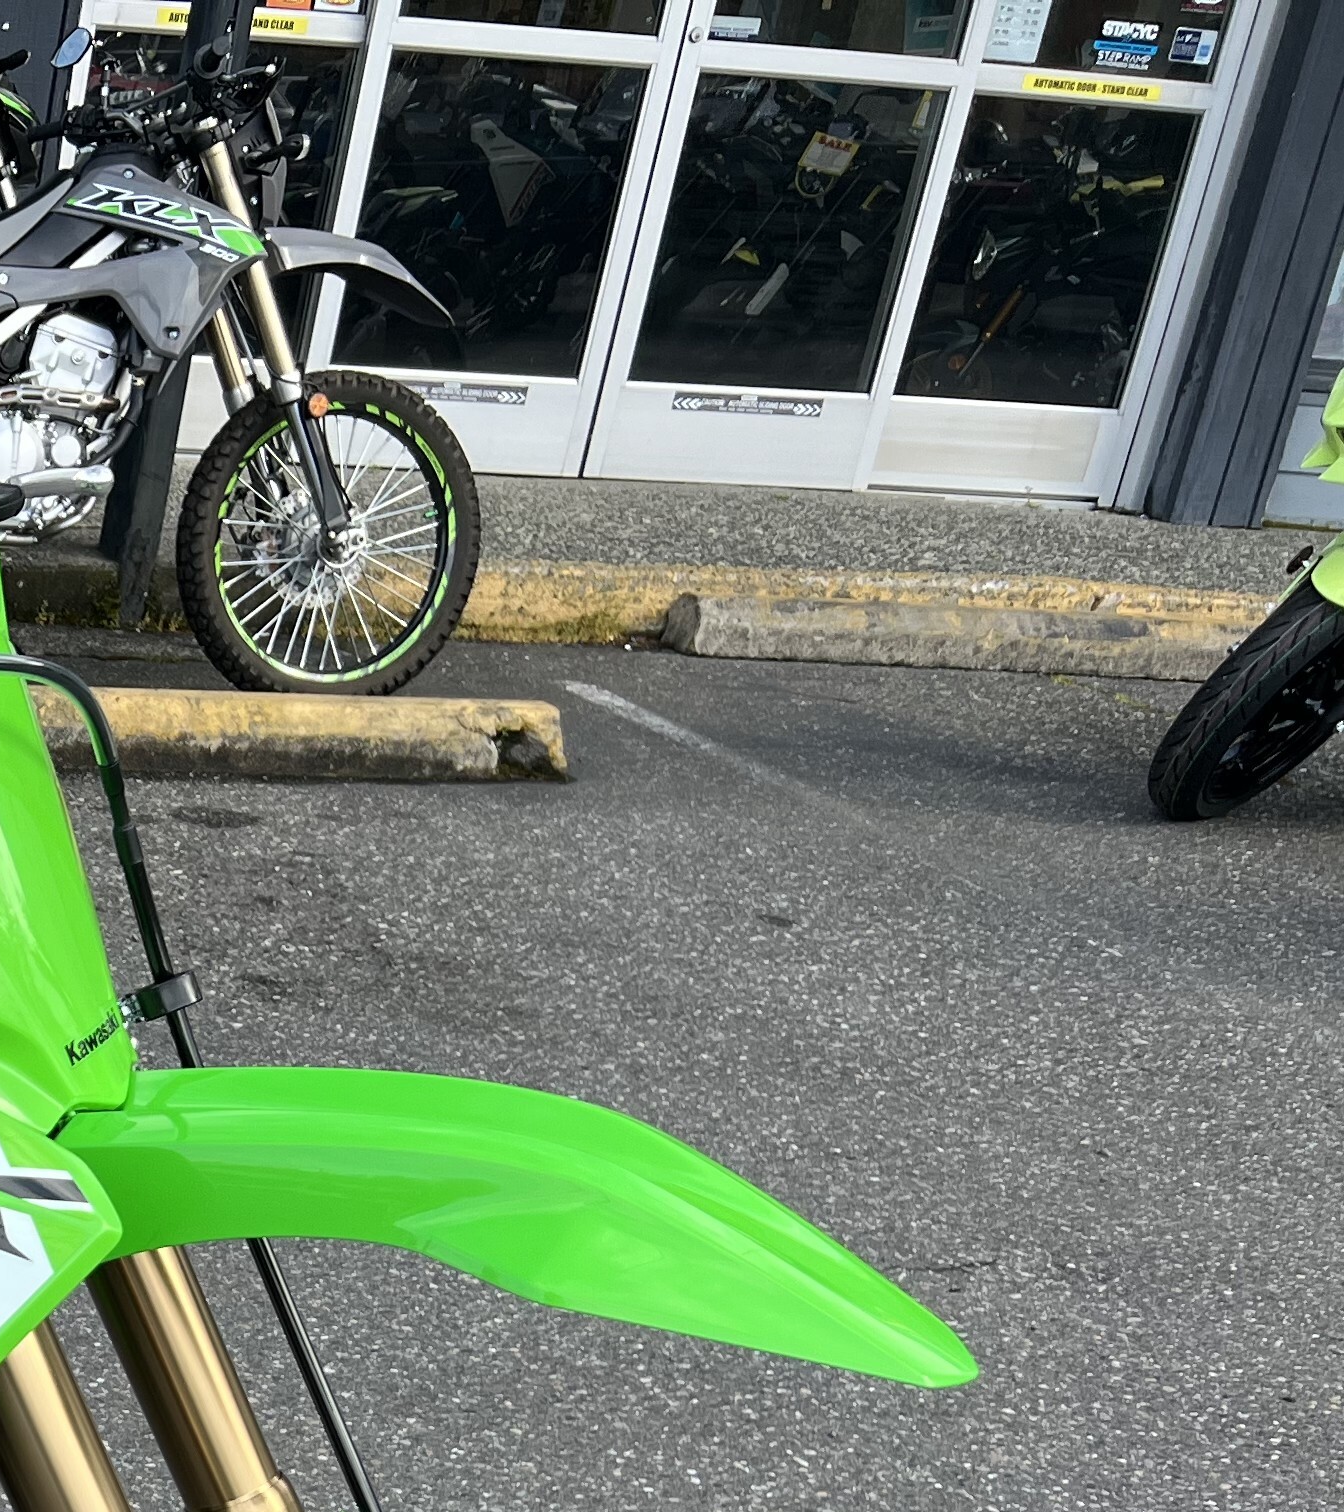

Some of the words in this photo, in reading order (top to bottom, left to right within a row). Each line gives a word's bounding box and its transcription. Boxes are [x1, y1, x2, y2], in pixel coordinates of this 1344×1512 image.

[1102, 20, 1159, 41] STACYC
[1034, 79, 1074, 92] AUTOMATIC
[75, 183, 252, 248] KLX
[64, 1007, 120, 1067] Kawasaki
